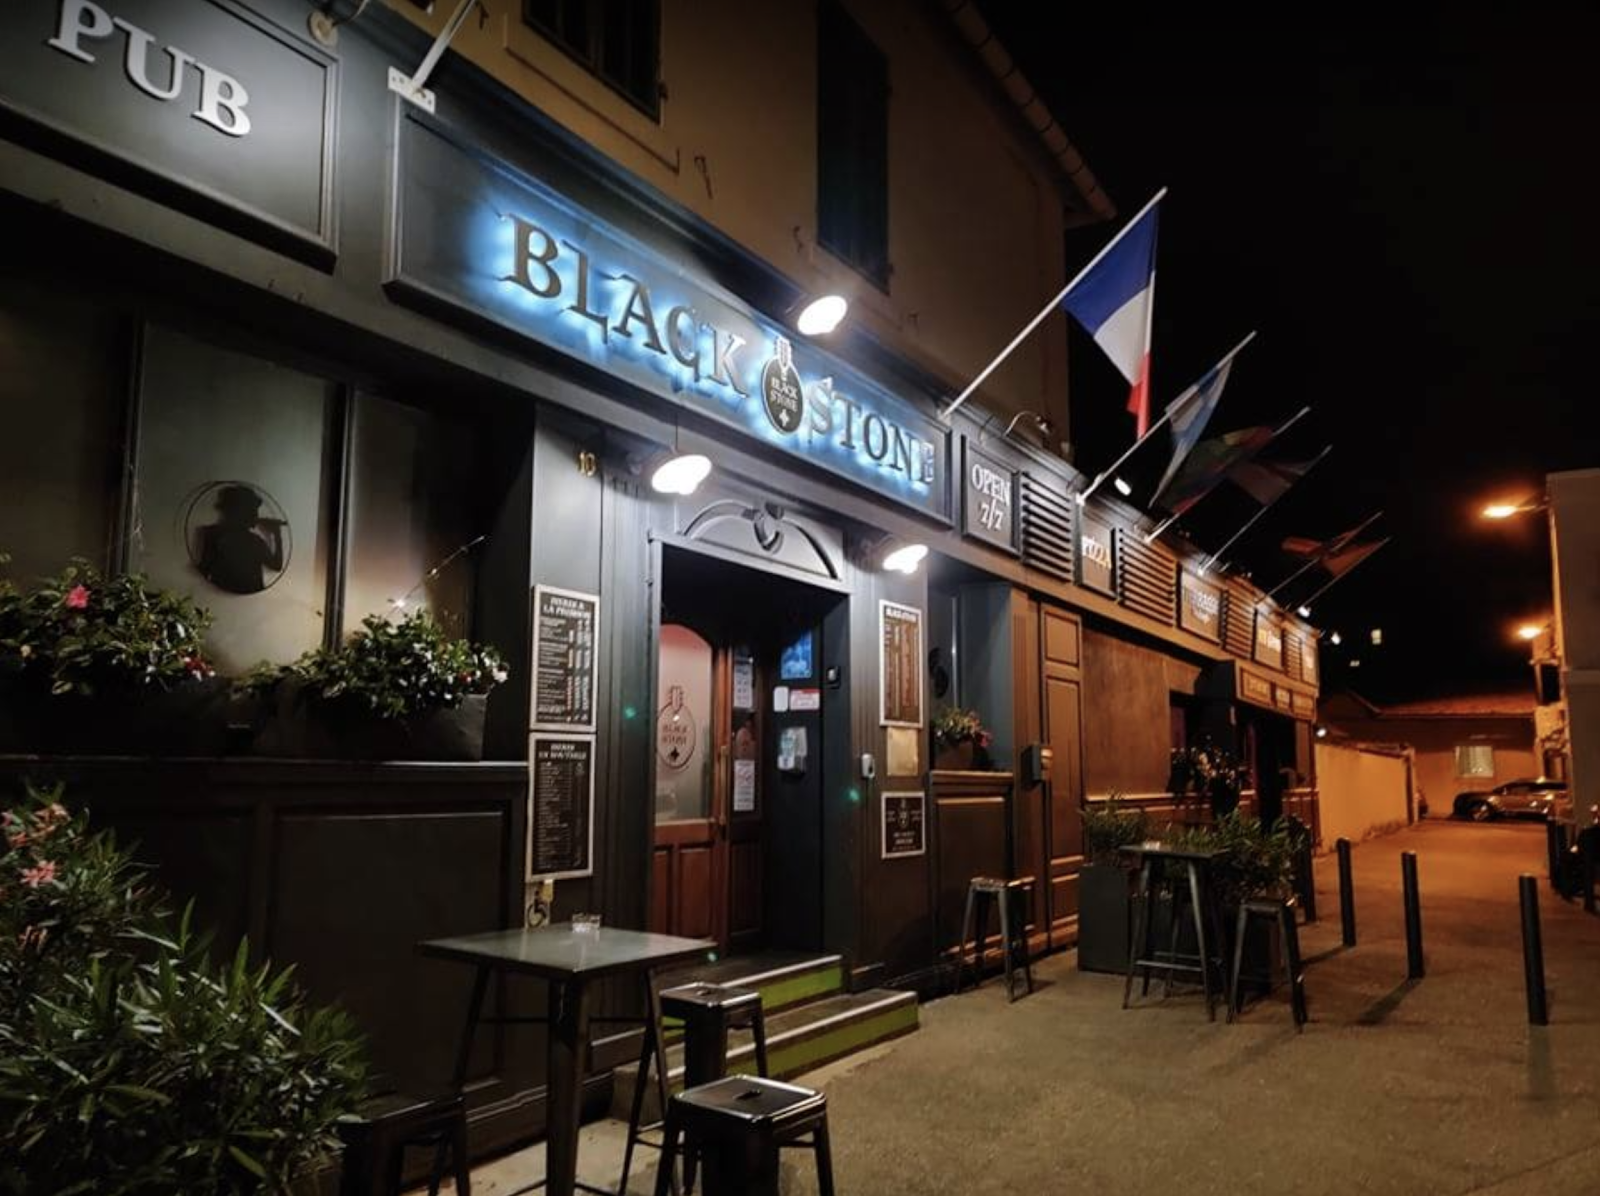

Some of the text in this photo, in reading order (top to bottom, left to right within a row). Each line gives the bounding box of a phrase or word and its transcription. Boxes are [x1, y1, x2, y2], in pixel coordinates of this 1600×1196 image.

[48, 0, 251, 136] PUB
[498, 212, 935, 485] BLACK STONE
[770, 376, 798, 399] BLACK
[972, 463, 1012, 507] OPEN
[981, 498, 1004, 531] 7/7
